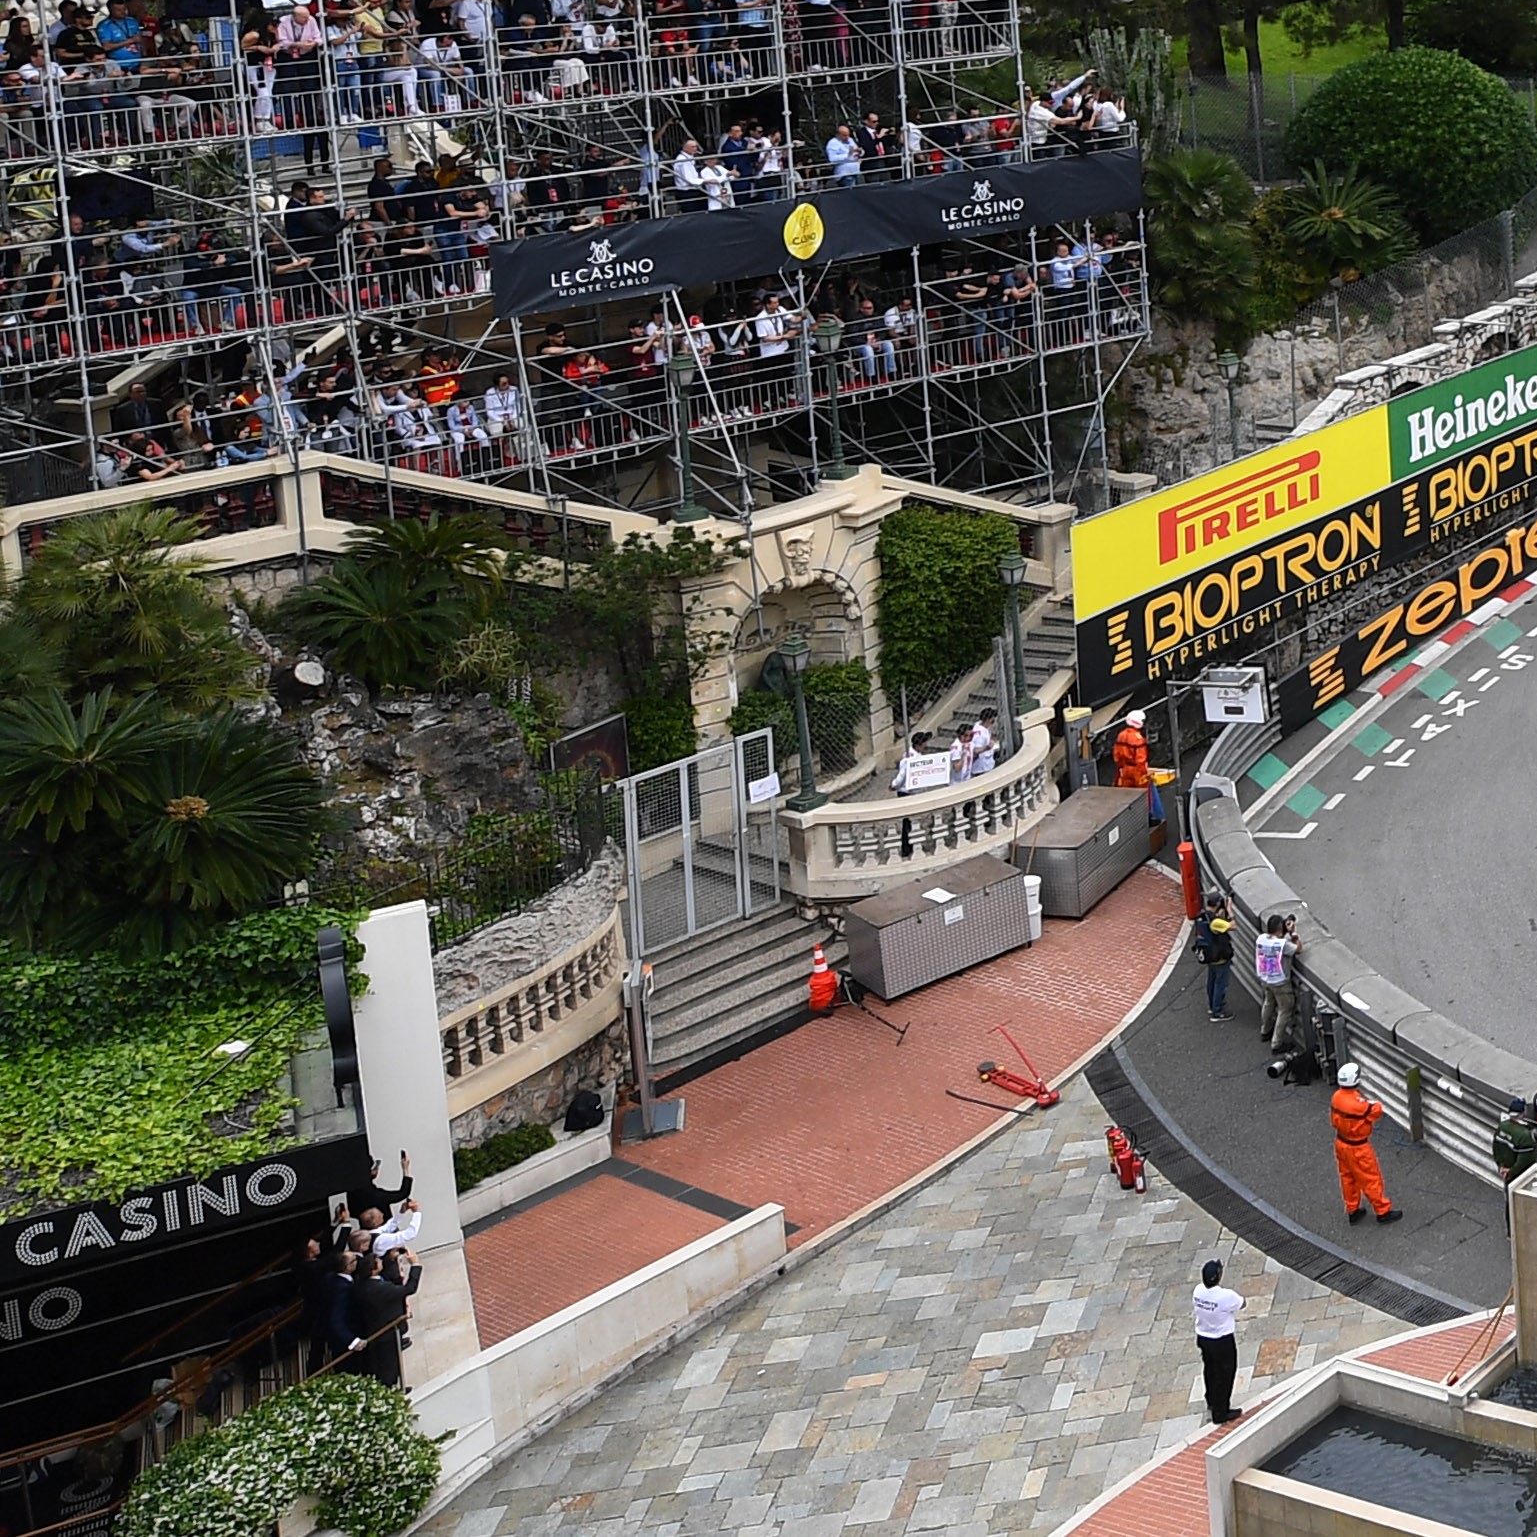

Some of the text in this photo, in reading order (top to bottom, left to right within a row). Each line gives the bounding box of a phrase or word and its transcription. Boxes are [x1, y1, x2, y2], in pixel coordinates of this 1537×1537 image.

[942, 197, 1025, 222] LE CASINO
[550, 258, 655, 289] LE CASINO
[1158, 449, 1322, 565] PIRELLI
[1429, 485, 1532, 543] HYPERLIGHT
[1144, 501, 1382, 656] BIOPTRON
[1147, 554, 1382, 680] HYPERLIGHT THERAPY
[15, 1162, 298, 1267] CASINO
